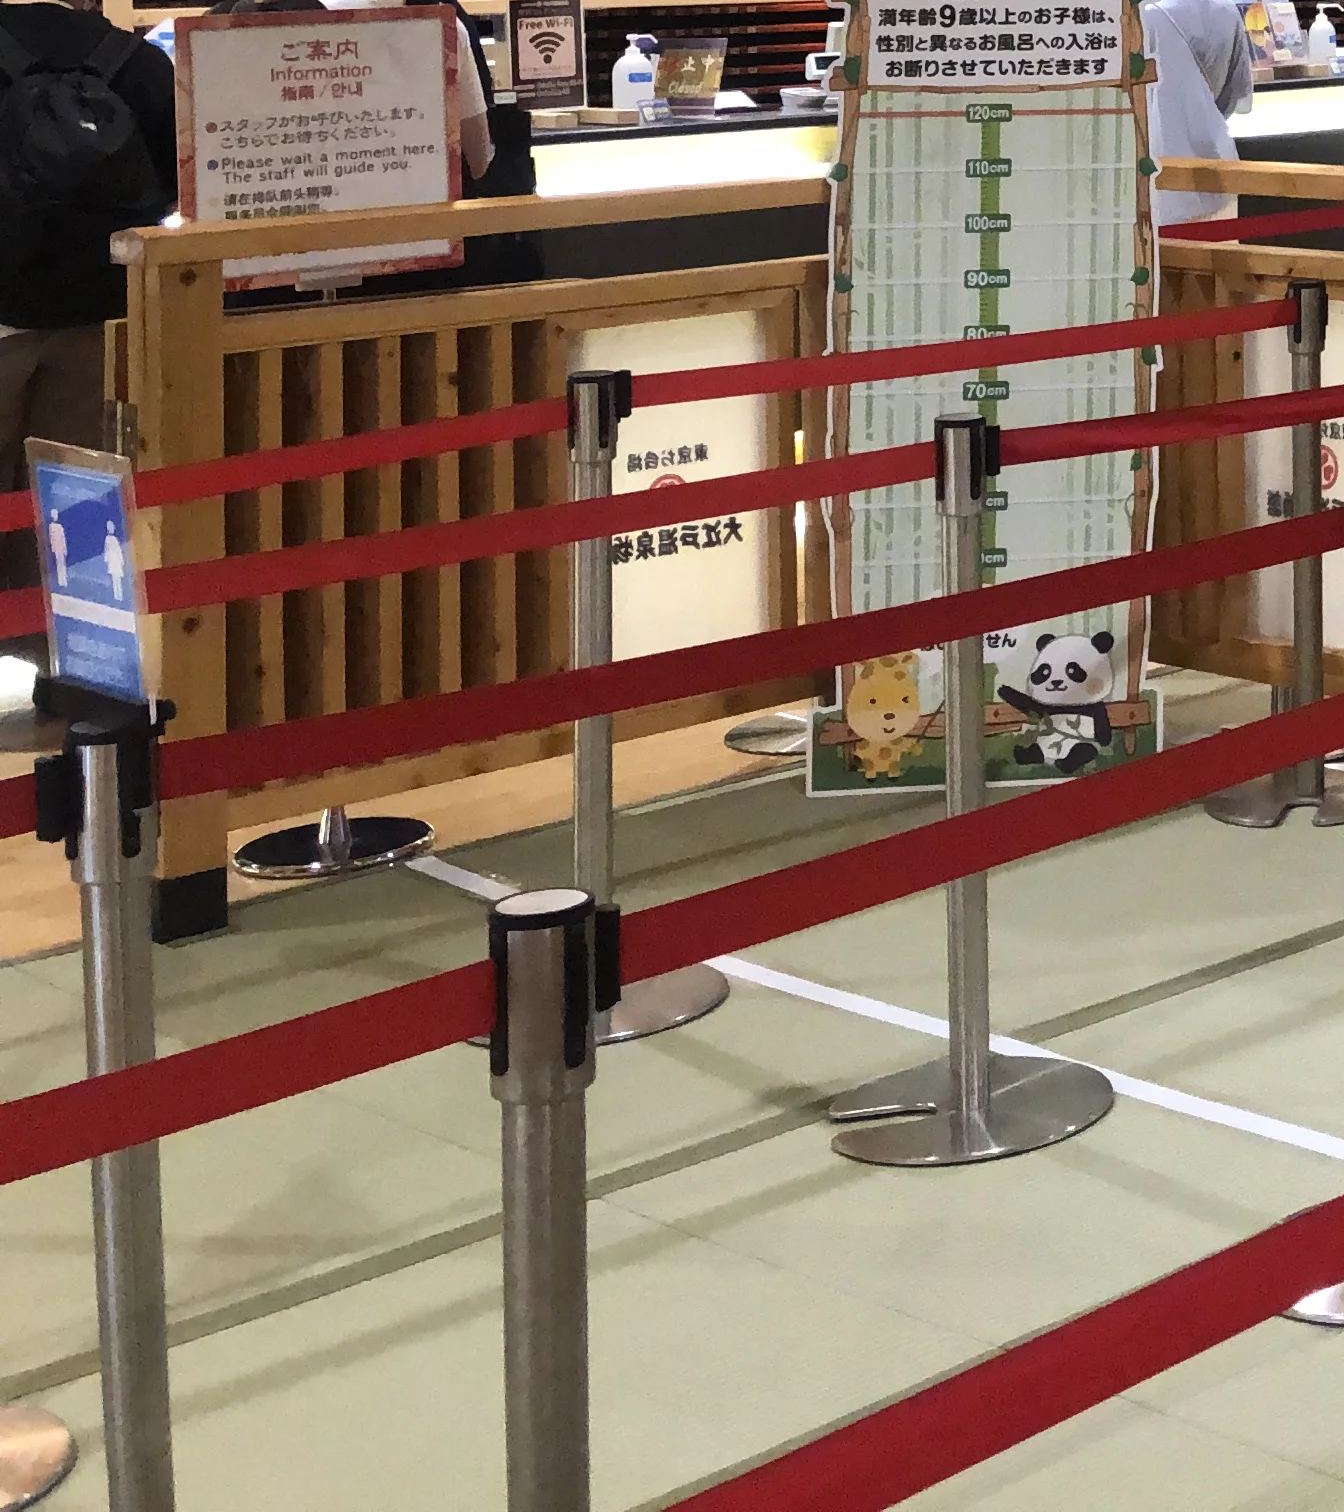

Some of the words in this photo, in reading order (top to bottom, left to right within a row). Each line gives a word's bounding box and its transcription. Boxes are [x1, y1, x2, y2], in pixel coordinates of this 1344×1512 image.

[518, 18, 543, 31] Free
[545, 16, 574, 29] Wi-Fi
[878, 4, 1115, 28] 満年齢9歳以上のお子様は、
[280, 39, 360, 62] ご案内
[875, 33, 1118, 53] 性別と異なるお風呂への入浴は
[269, 64, 373, 83] Information
[885, 58, 1108, 78] お断りさせていただきます
[667, 80, 705, 95] Closed
[219, 107, 425, 133] スタッフがお呼びいたします。
[967, 105, 1010, 121] 120cm
[221, 155, 274, 170] Please
[280, 152, 313, 166] wait
[319, 153, 328, 163] a
[334, 145, 397, 162] moment
[222, 170, 253, 186] The
[258, 167, 297, 182] staff
[302, 164, 329, 178] will
[333, 161, 375, 179] guide
[967, 161, 1009, 174] 110cm
[966, 216, 1009, 231] 100cm
[966, 272, 1009, 286] 90cm
[966, 383, 1008, 399] 70cm
